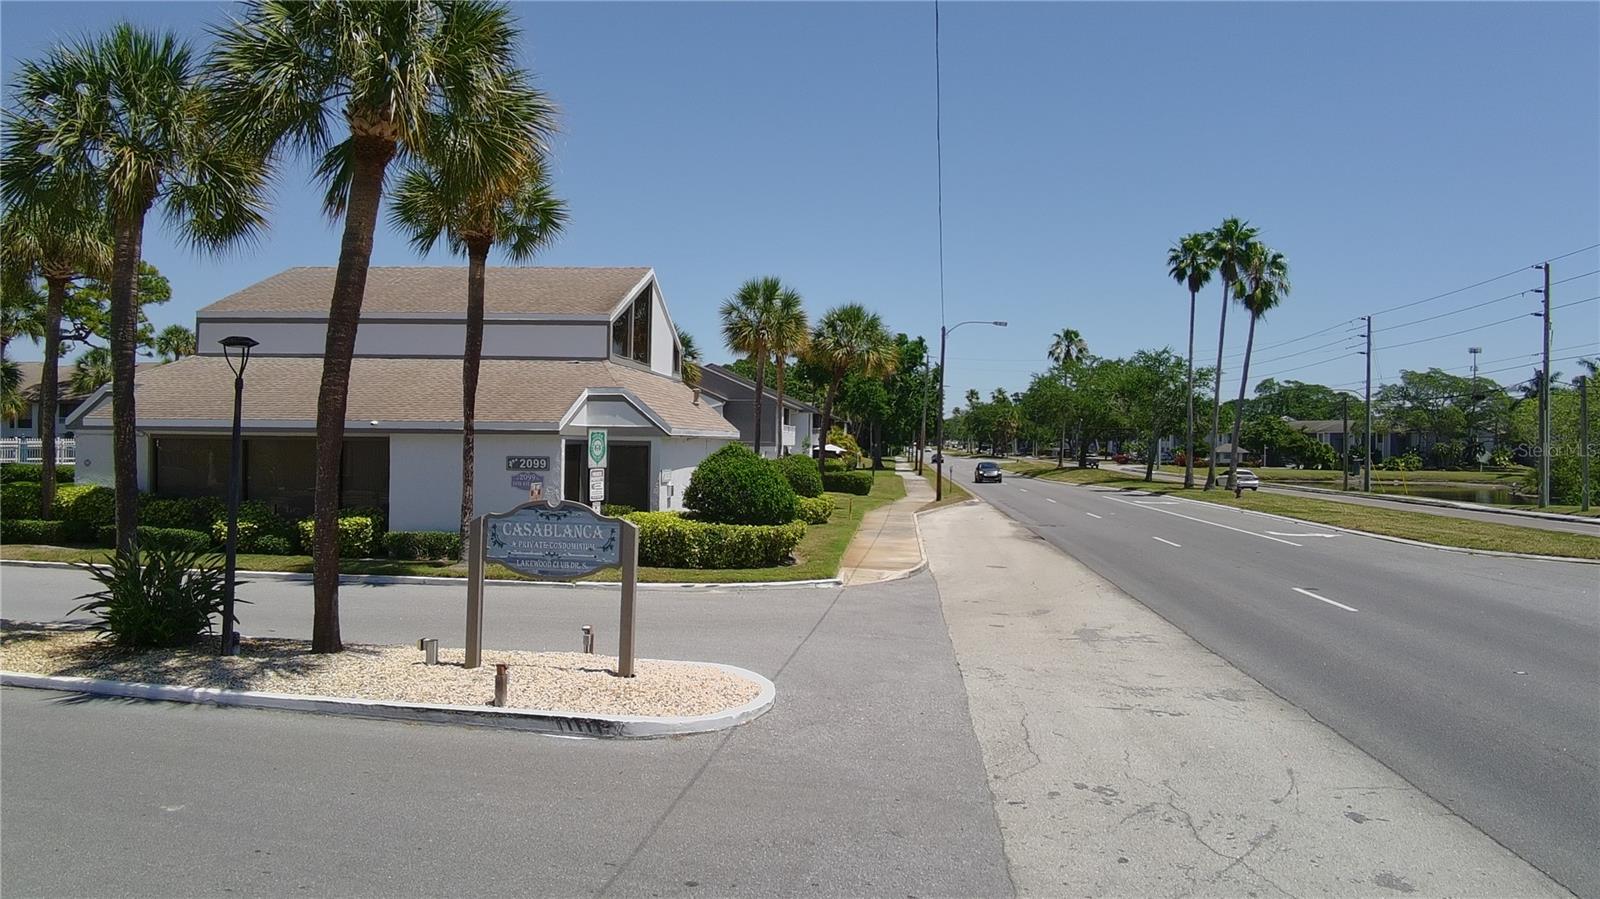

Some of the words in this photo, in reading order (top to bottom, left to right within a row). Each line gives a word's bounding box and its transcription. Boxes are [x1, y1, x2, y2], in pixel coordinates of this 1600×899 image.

[519, 458, 547, 469] 2099
[502, 521, 603, 540] CASABLANCA
[516, 560, 552, 569] LAKEWOOD
[552, 560, 570, 569] CLUB
